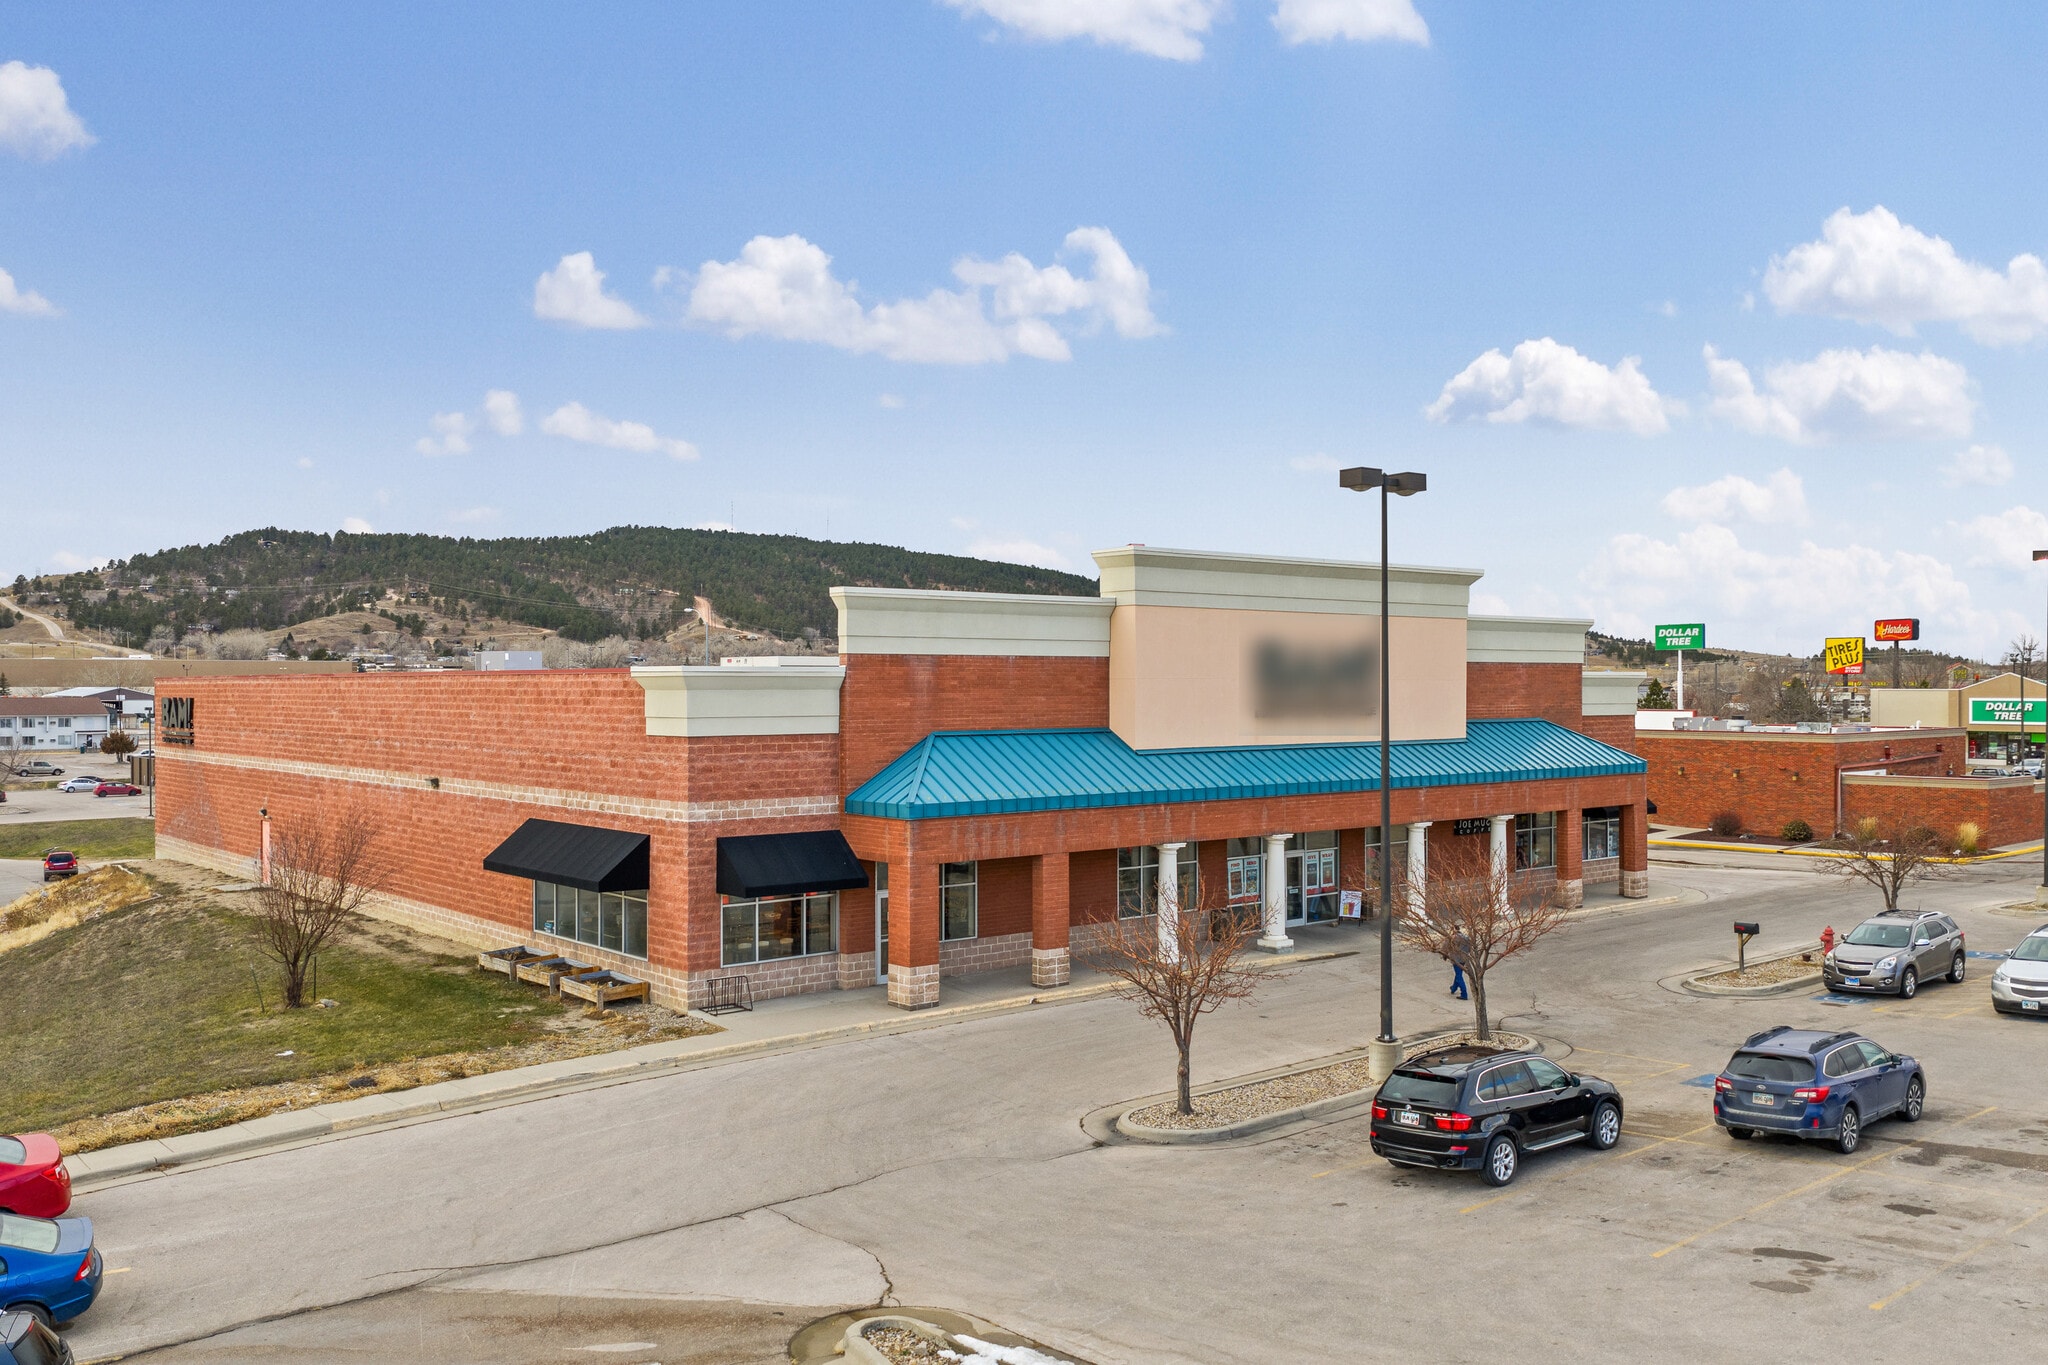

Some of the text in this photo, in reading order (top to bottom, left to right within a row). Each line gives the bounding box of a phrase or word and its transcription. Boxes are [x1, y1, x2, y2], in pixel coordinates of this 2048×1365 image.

[1658, 627, 1700, 638] DOLLAR
[1665, 637, 1692, 646] TREE
[1827, 639, 1859, 658] TIRES
[1832, 651, 1860, 669] PLUS
[1985, 702, 2033, 711] DOLLAR
[161, 697, 194, 729] BAM!
[1994, 711, 2022, 720] TREE
[1459, 819, 1472, 829] JOE
